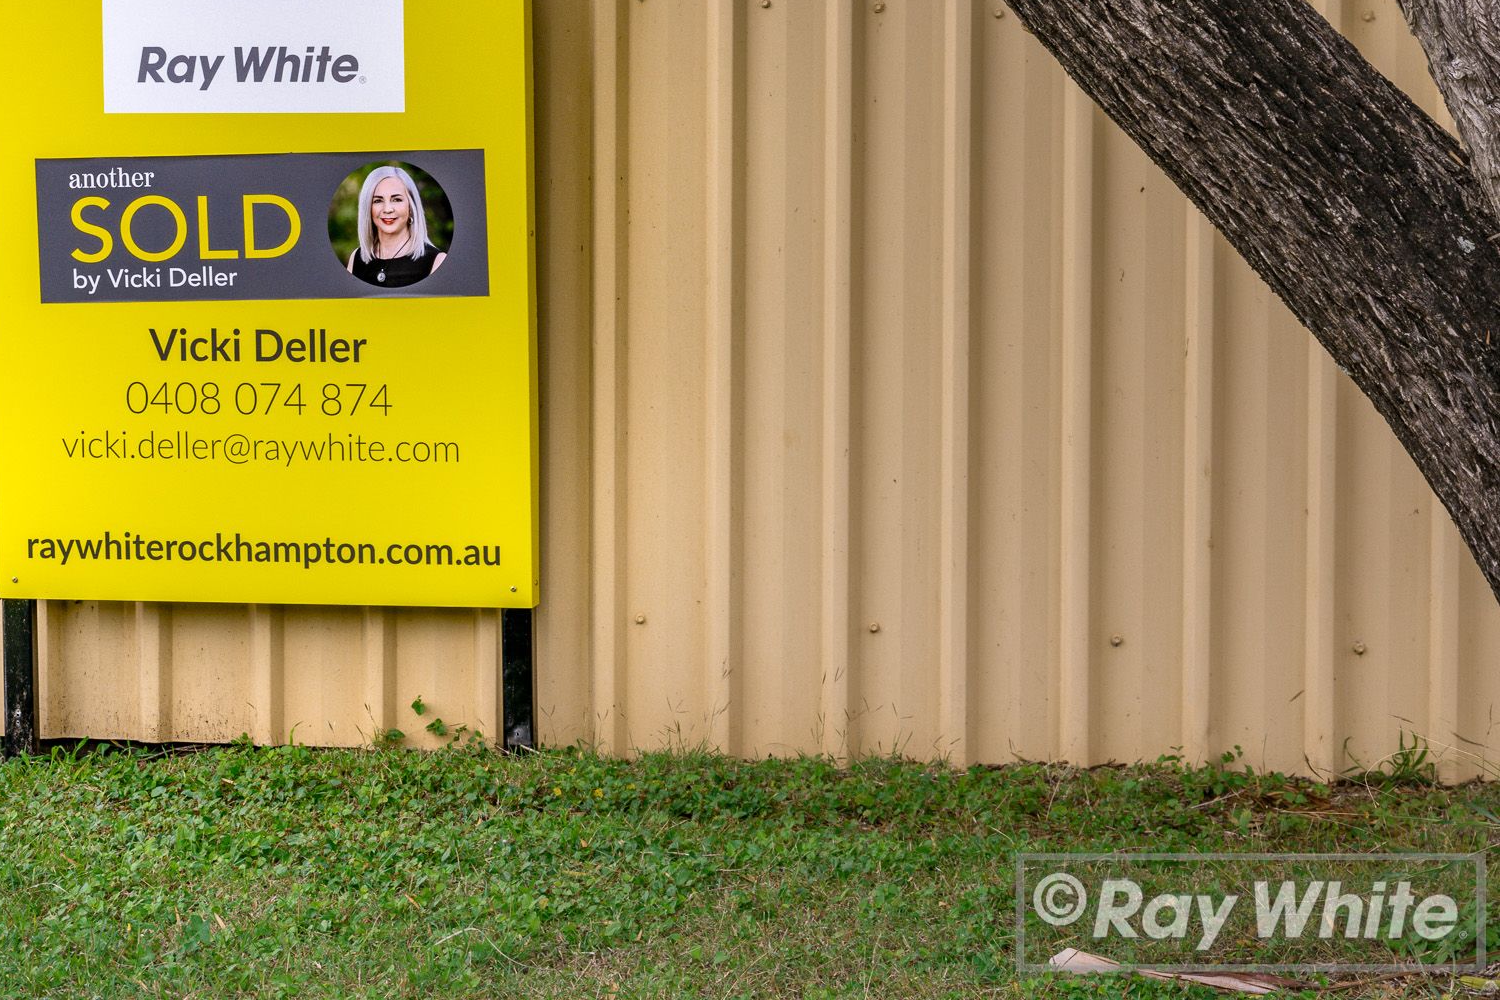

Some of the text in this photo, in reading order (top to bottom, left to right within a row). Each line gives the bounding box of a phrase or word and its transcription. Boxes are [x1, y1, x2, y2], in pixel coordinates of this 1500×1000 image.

[137, 46, 224, 90] Ray
[68, 168, 154, 189] another
[70, 194, 302, 263] SOLD
[72, 267, 238, 294] by Vicki Deller
[149, 328, 367, 363] Vicki Deller
[126, 381, 393, 416] 0408 074 874
[62, 430, 460, 467] vicki.deller@raywhite.com
[27, 531, 501, 569] raywhiterockhampton.com.au
